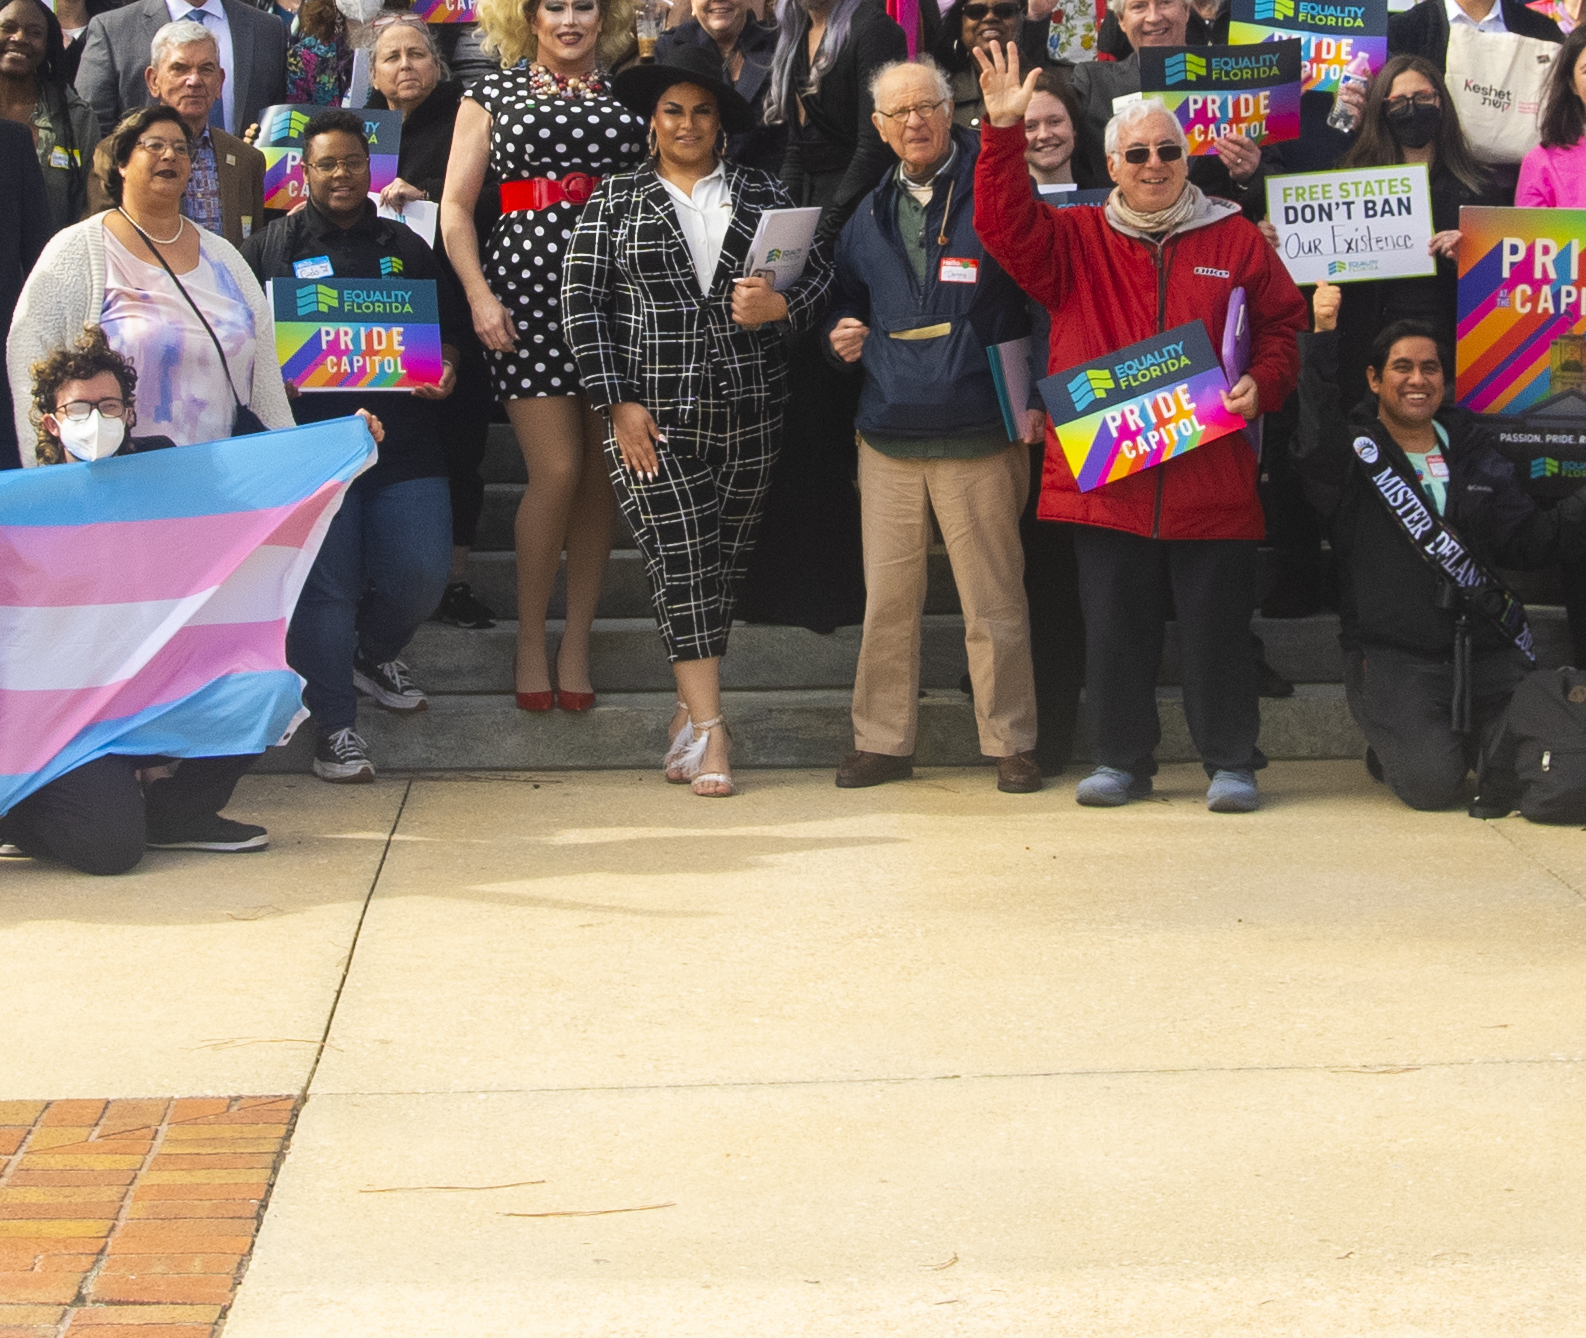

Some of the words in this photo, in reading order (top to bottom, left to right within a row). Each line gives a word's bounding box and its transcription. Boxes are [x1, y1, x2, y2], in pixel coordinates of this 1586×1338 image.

[1298, 13, 1364, 28] FLORIDA
[1299, 1, 1365, 18] EQUALITY
[1212, 53, 1280, 70] EQUALITY
[1212, 66, 1280, 81] FLORIDA
[1464, 79, 1512, 102] Keshet
[1188, 91, 1271, 118] PRIDE
[1194, 121, 1269, 141] CAPITOL
[1281, 183, 1333, 203] FREE
[1338, 176, 1412, 198] STATES
[1284, 200, 1356, 224] DON'T
[1362, 196, 1412, 218] BAN
[343, 289, 412, 302] EQUALITY
[344, 302, 413, 313] FLORIDA
[320, 326, 405, 350] PRIDE
[326, 355, 406, 373] CAPITOL
[1115, 341, 1184, 379] EQUALITY
[1119, 355, 1191, 390] FLORIDA
[1105, 384, 1196, 438] PRIDE
[1122, 415, 1205, 459] CAPITOL
[1500, 433, 1543, 443] PASSION.
[1545, 435, 1576, 444] PRIDE.
[1372, 467, 1433, 540] MISTER
